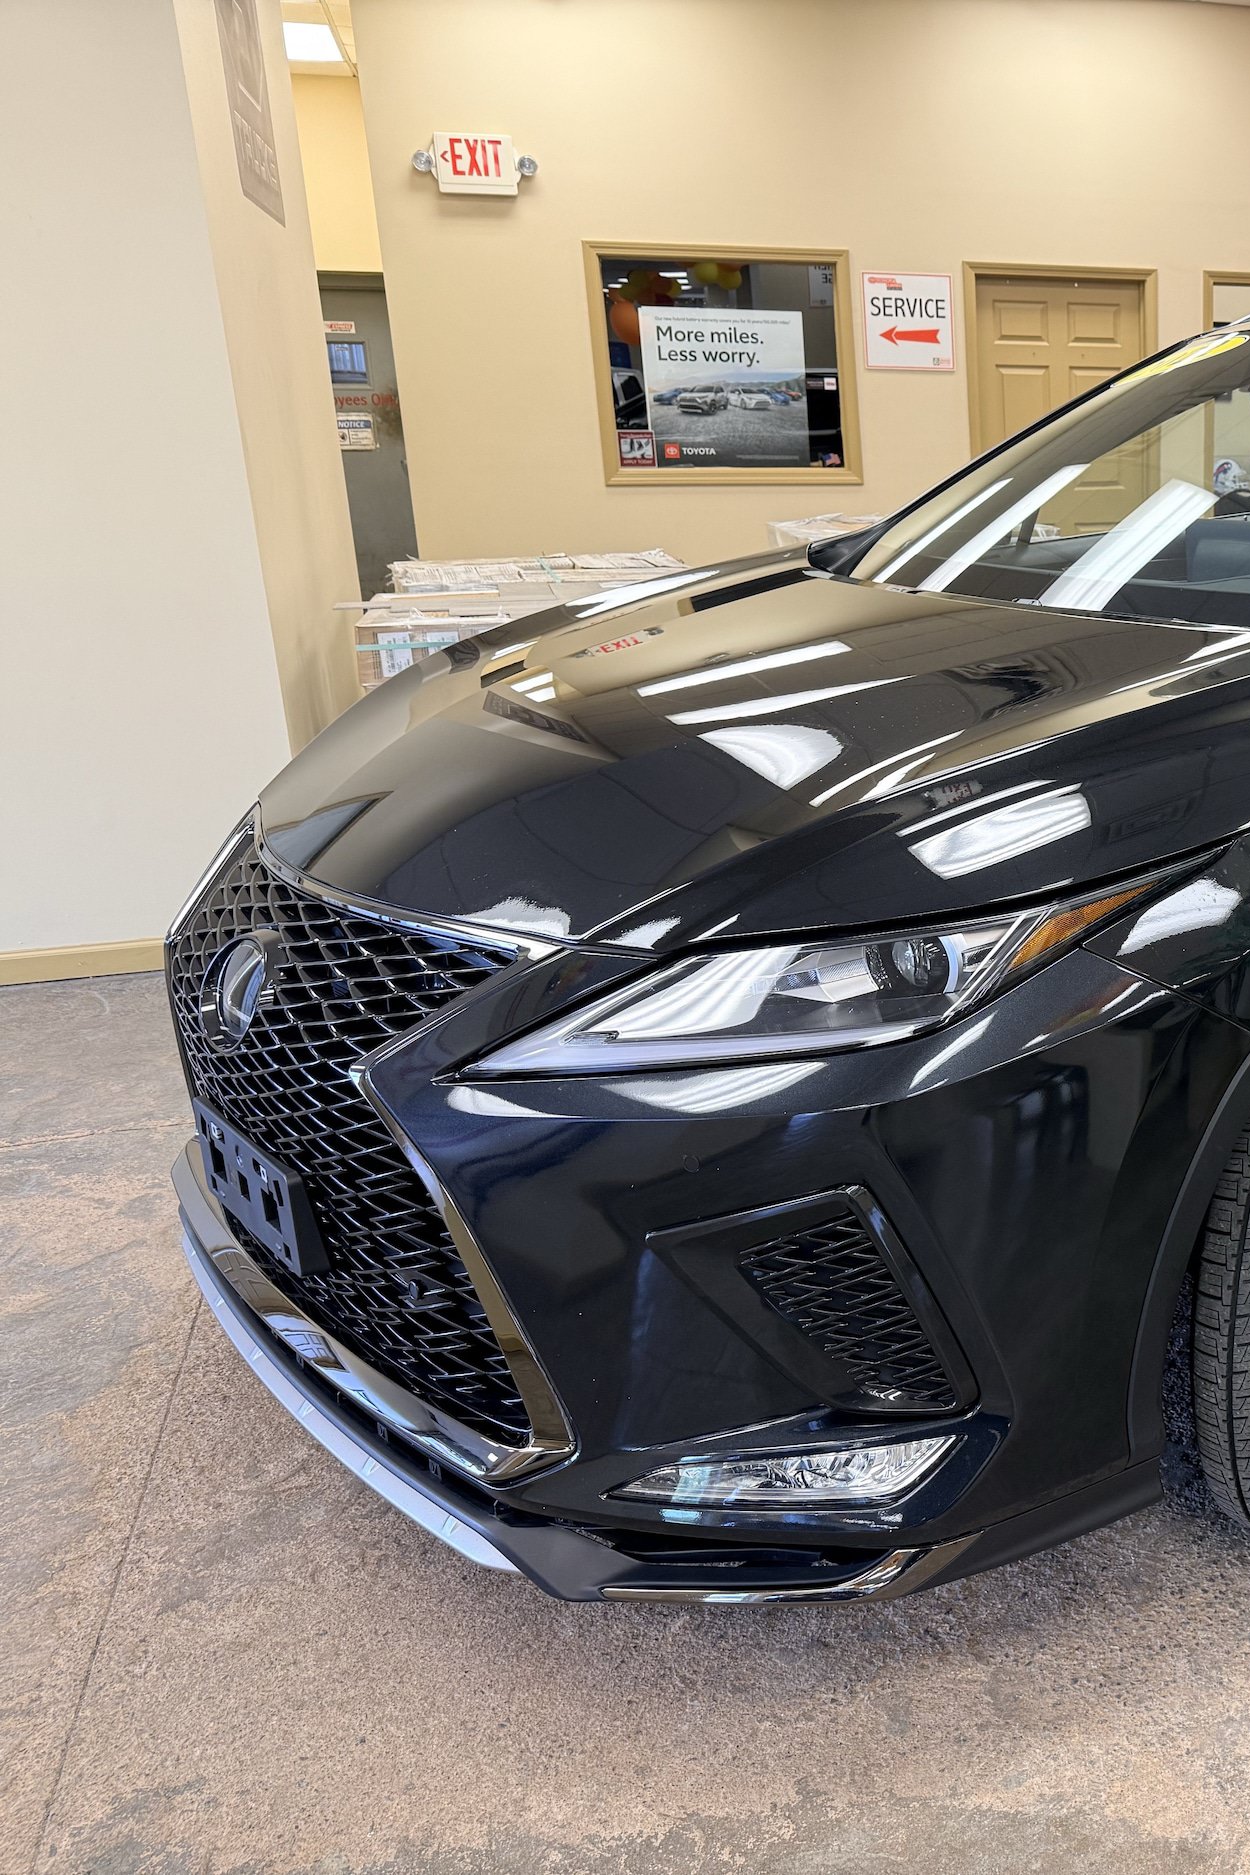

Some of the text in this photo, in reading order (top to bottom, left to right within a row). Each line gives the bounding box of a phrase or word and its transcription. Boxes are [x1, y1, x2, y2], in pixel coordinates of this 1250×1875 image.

[449, 138, 502, 177] EXIT
[870, 296, 946, 318] SERVICE
[656, 325, 764, 344] More miles.
[658, 345, 760, 367] Less worry.
[682, 447, 716, 456] TOYOTA
